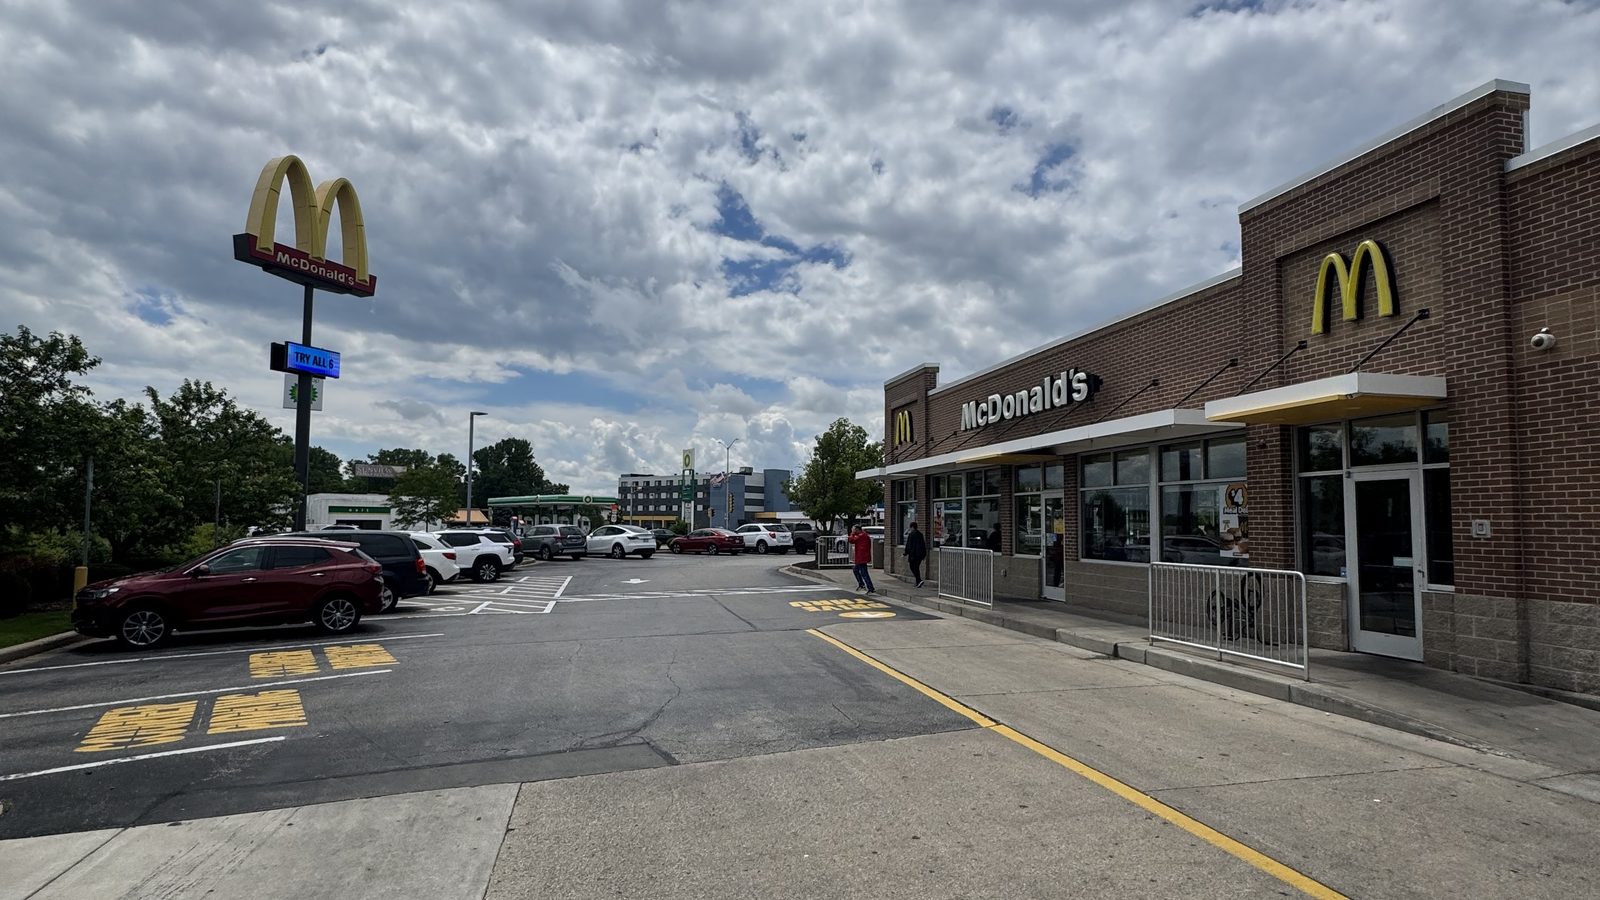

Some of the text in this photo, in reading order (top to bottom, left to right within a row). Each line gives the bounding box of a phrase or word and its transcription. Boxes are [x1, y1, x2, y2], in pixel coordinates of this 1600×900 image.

[276, 251, 355, 286] McDonald's
[294, 351, 334, 370] TRY ALL 6
[960, 368, 1089, 431] McDonald's
[73, 700, 198, 752] COURIER
[207, 689, 309, 735] PARKING
